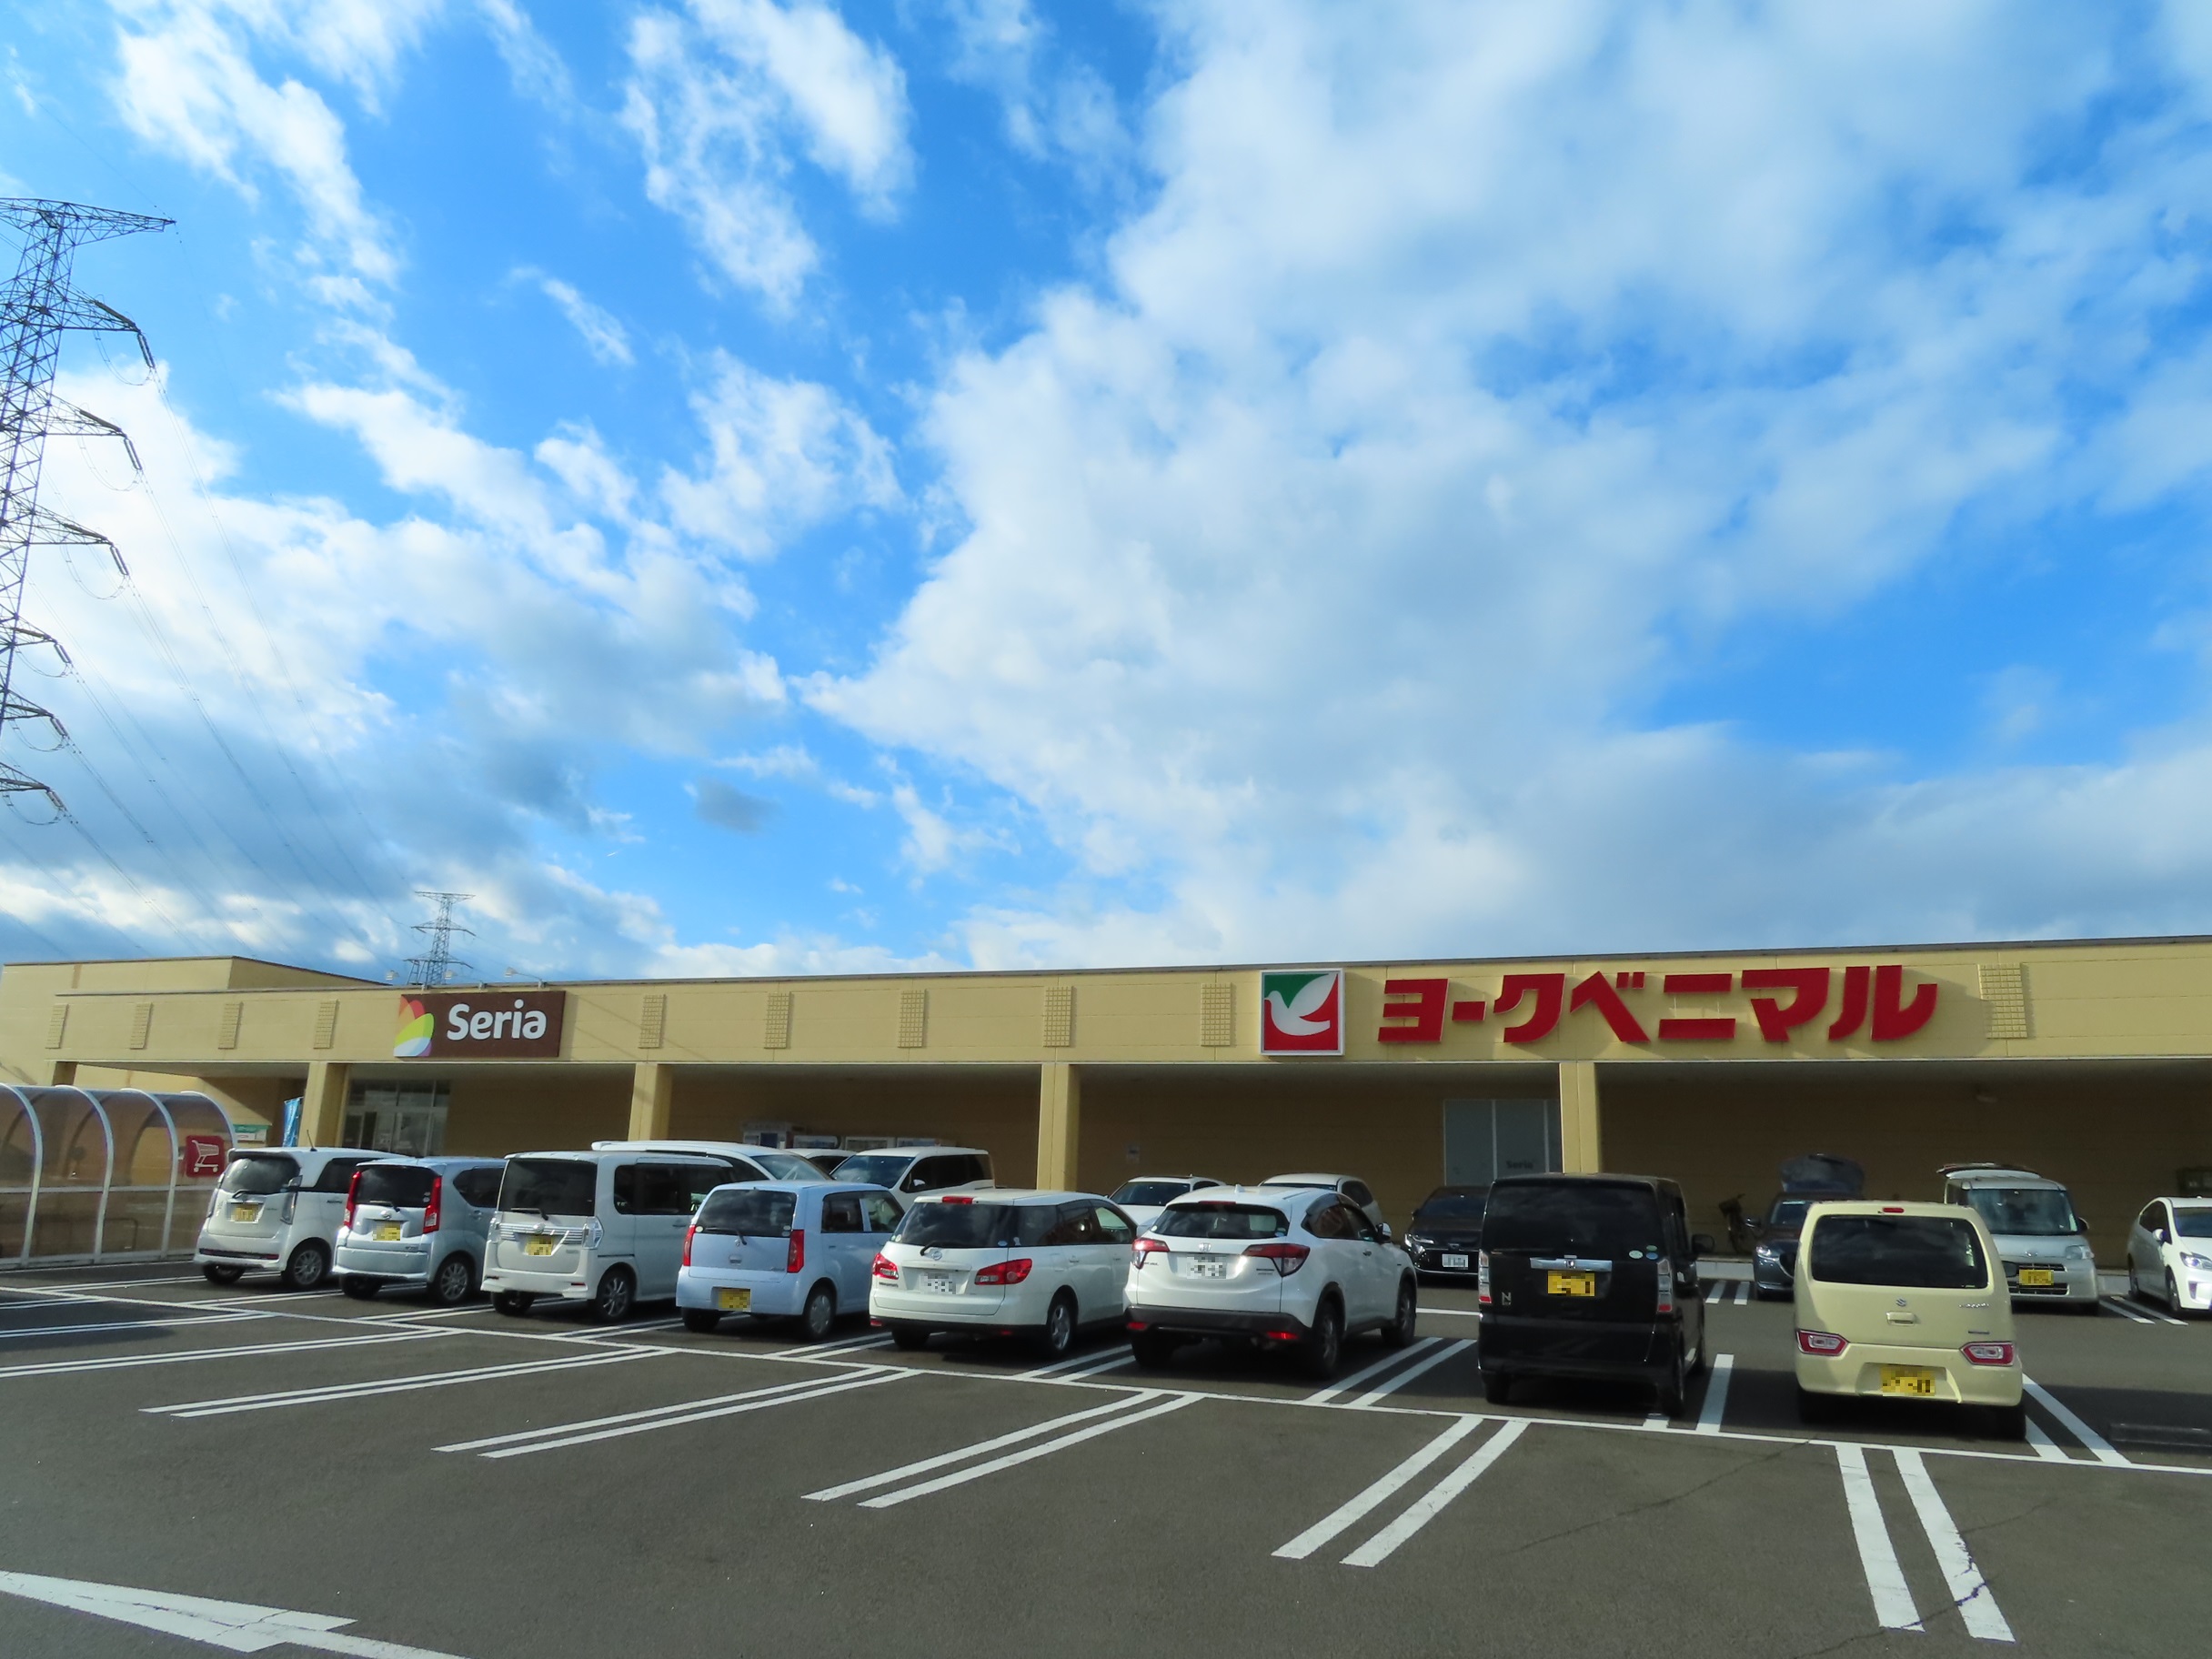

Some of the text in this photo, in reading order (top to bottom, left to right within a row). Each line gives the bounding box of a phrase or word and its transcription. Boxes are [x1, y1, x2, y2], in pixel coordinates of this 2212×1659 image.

[447, 999, 547, 1041] Seria
[1379, 966, 1938, 1043] ヨークベニマル
